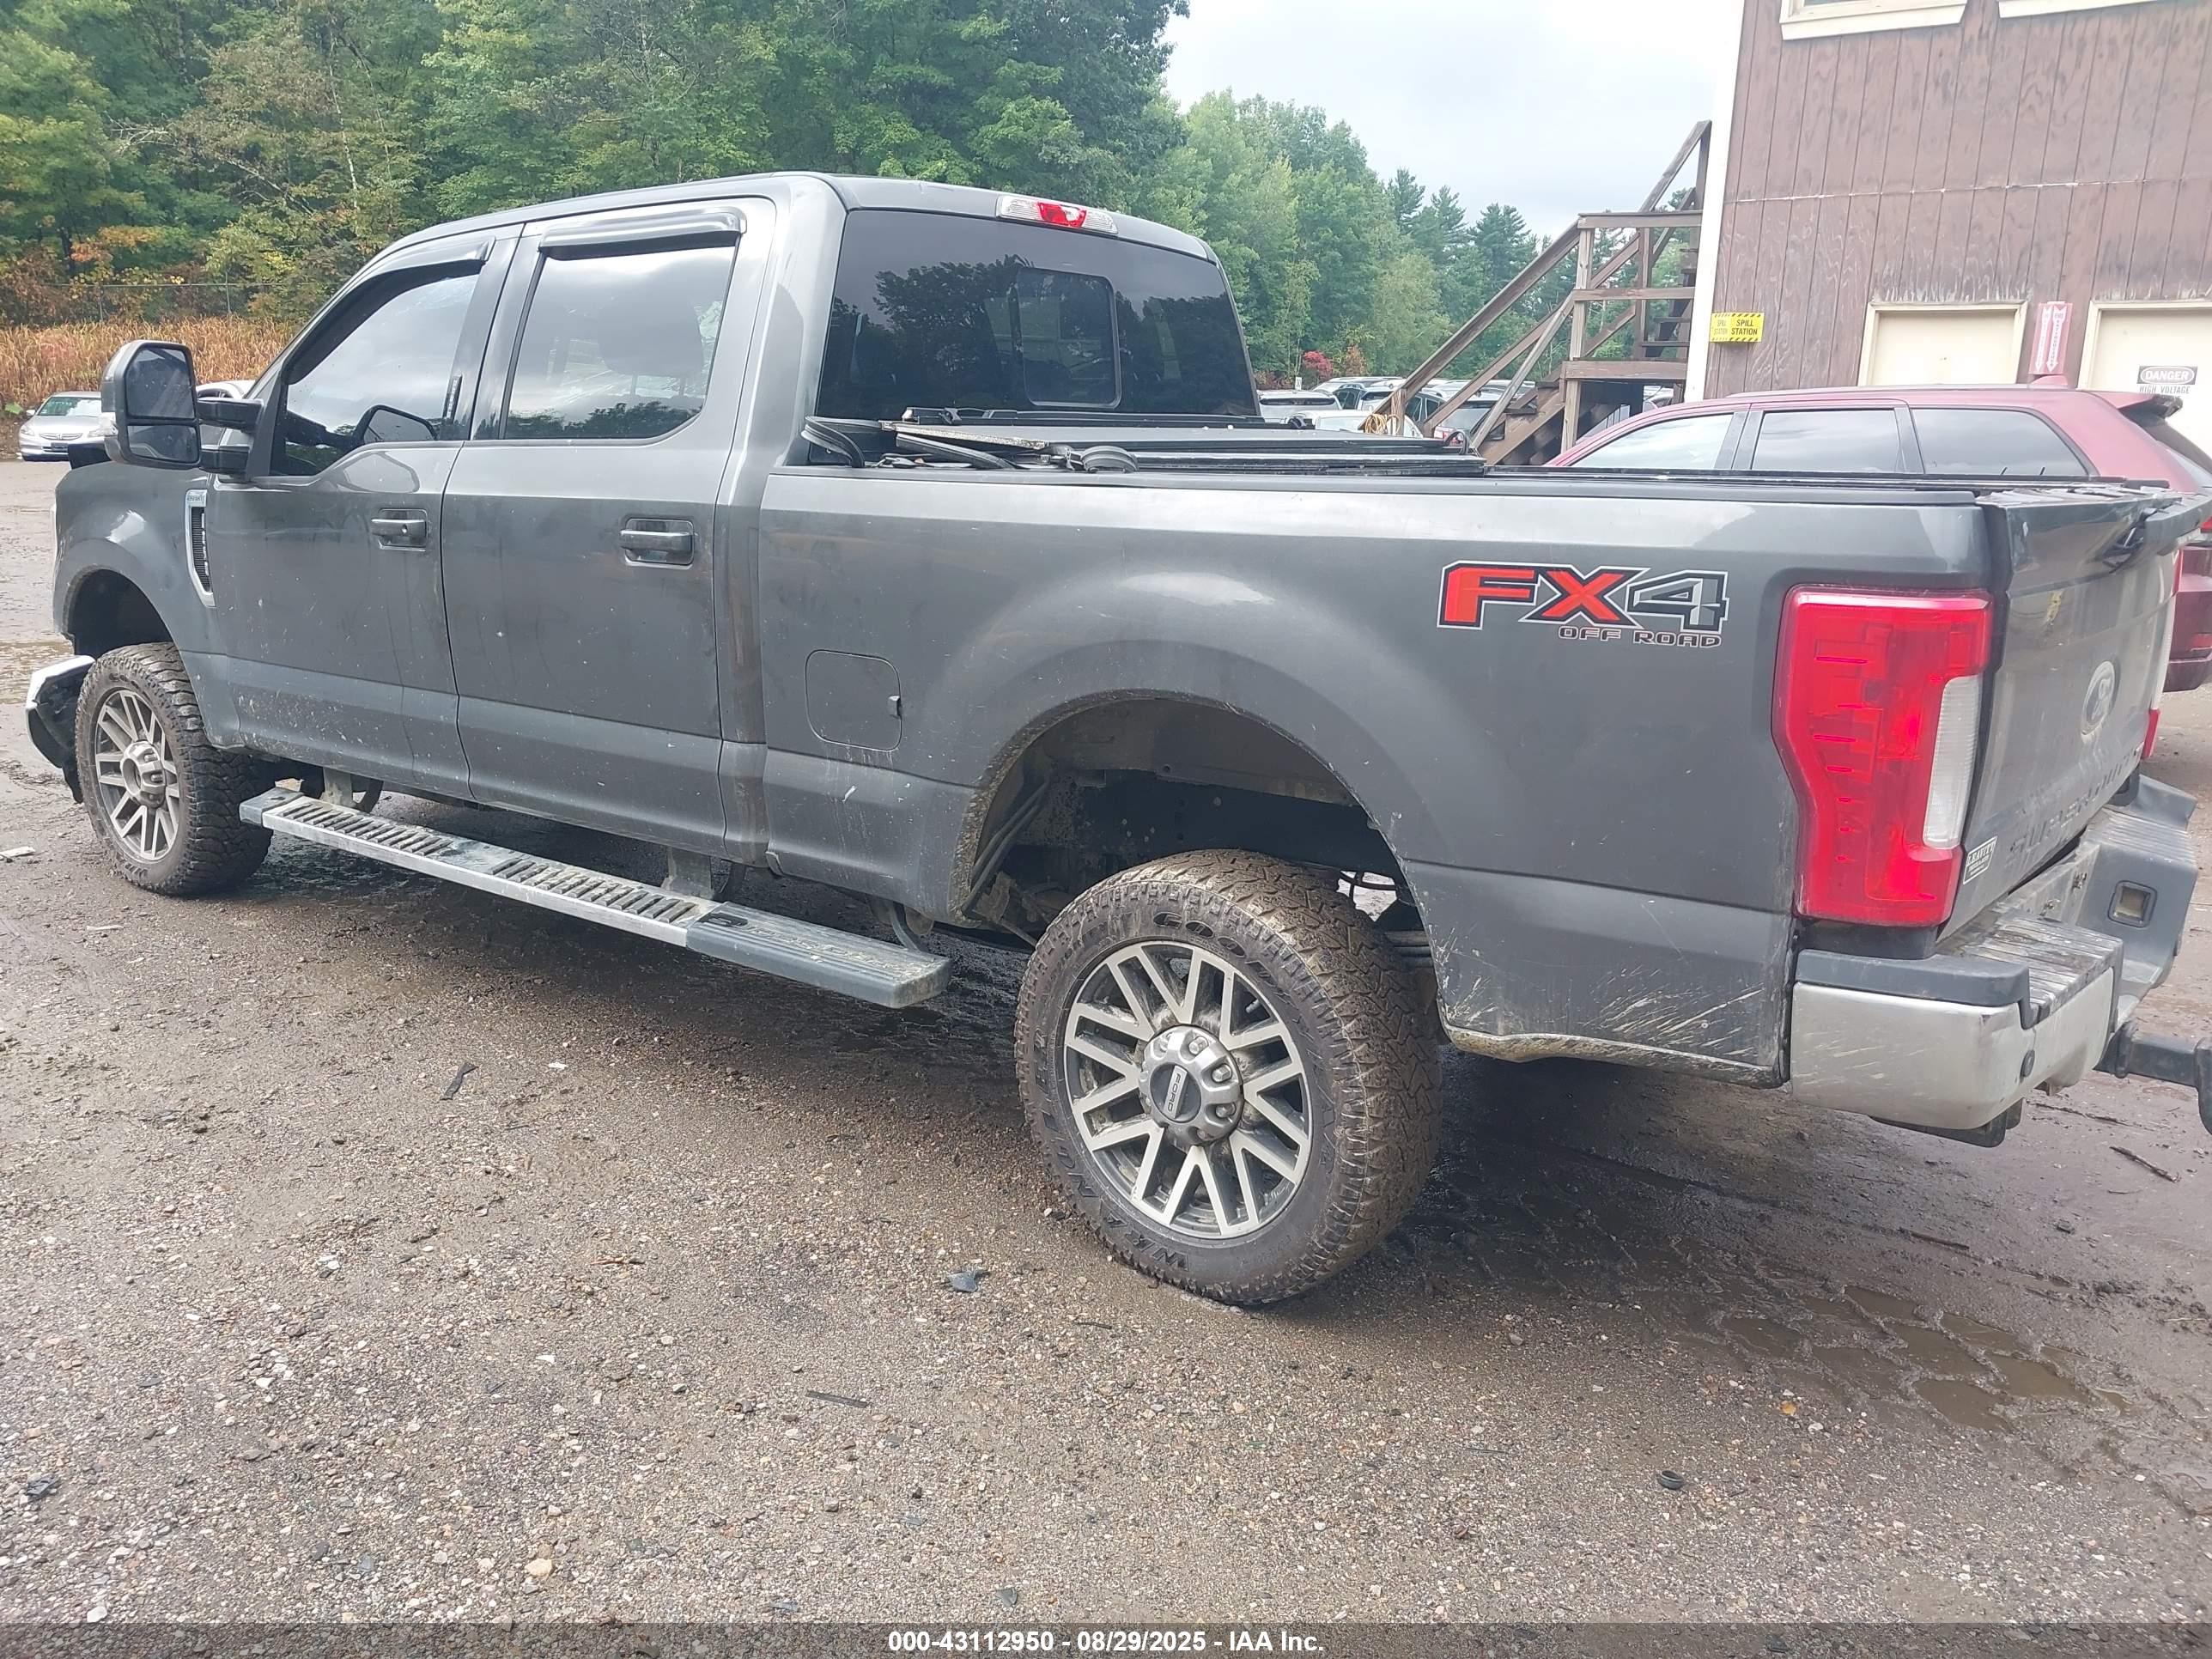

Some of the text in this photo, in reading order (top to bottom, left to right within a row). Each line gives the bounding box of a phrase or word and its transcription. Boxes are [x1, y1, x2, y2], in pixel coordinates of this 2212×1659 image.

[1735, 319, 1753, 327] SPILL
[1730, 327, 1758, 336] STATION
[2145, 370, 2190, 380] DANGER
[2139, 385, 2191, 394] HIGH VOLTAGE
[1437, 560, 1729, 634] FX4
[1558, 626, 1723, 648] OFF ROAD
[1166, 1073, 1182, 1113] FORD
